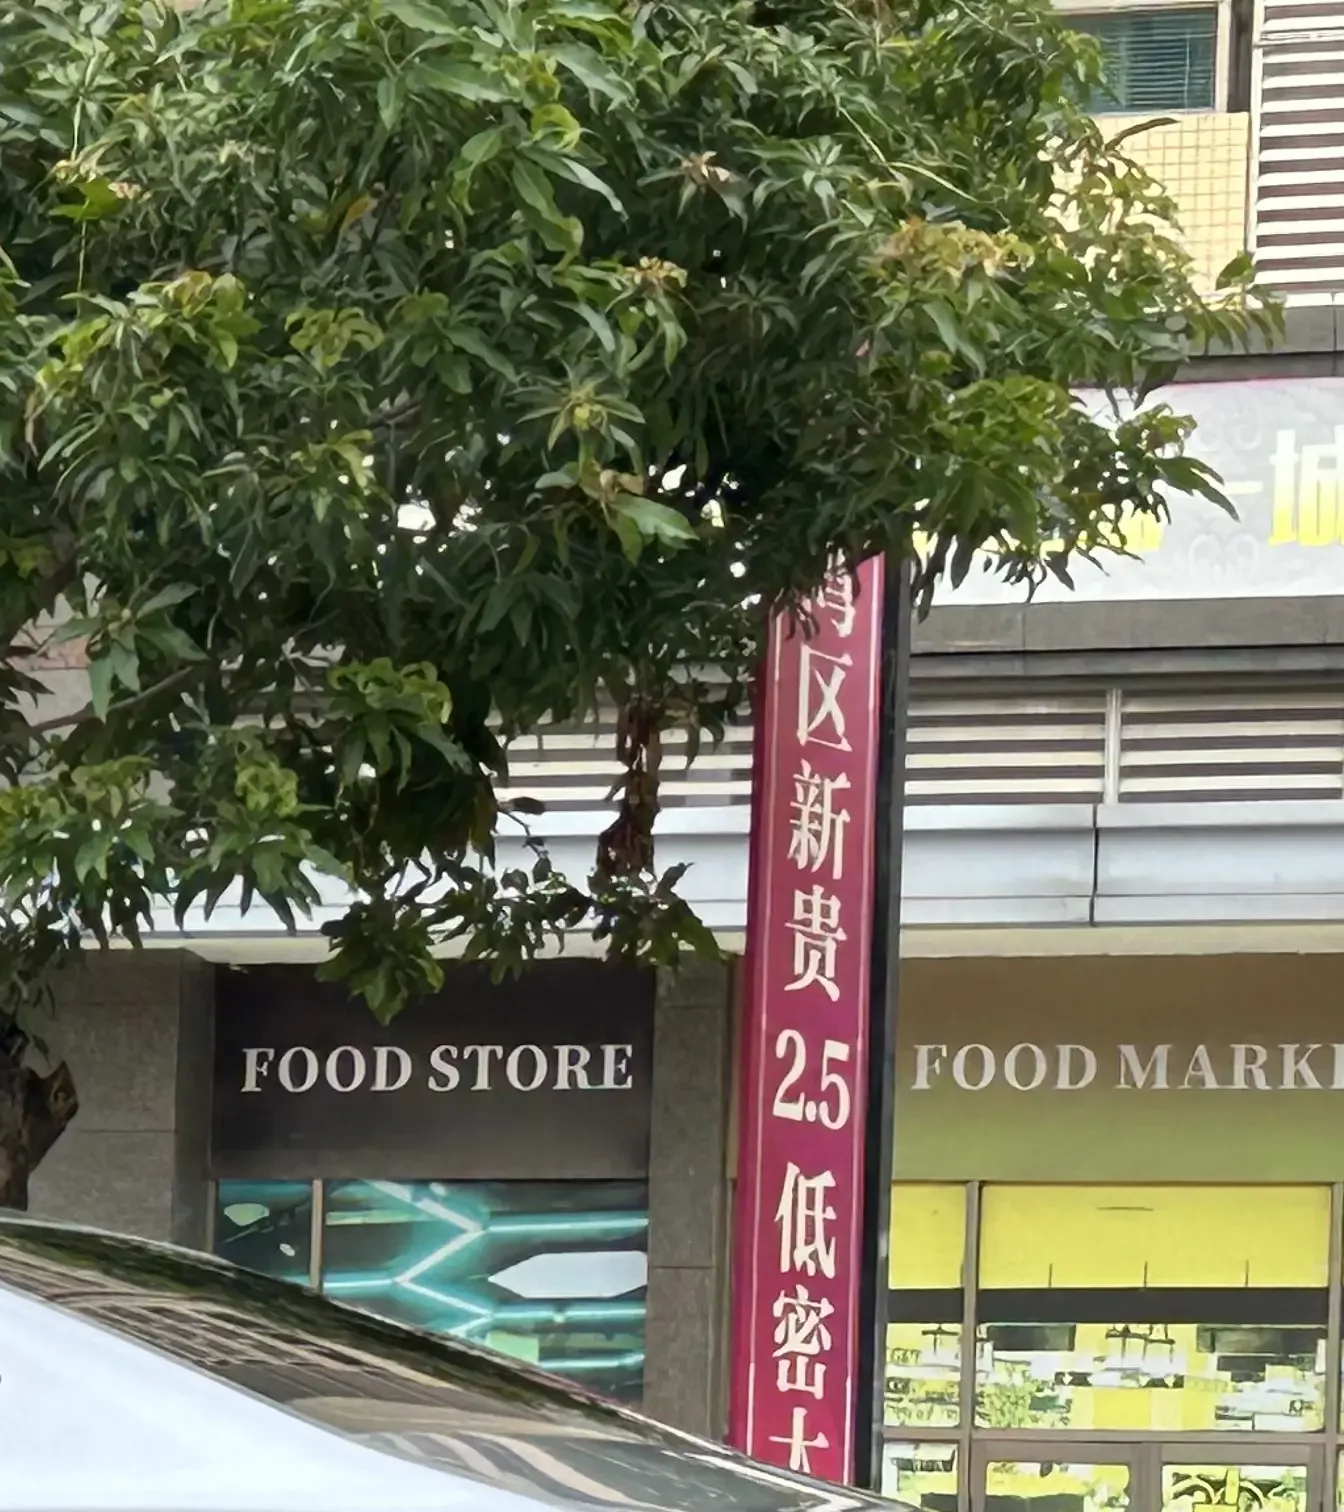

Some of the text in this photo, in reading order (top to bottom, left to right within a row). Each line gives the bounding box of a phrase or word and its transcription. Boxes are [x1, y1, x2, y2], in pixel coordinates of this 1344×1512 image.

[241, 1044, 633, 1093] FOOD STORE
[911, 1043, 1098, 1091] FOOD
